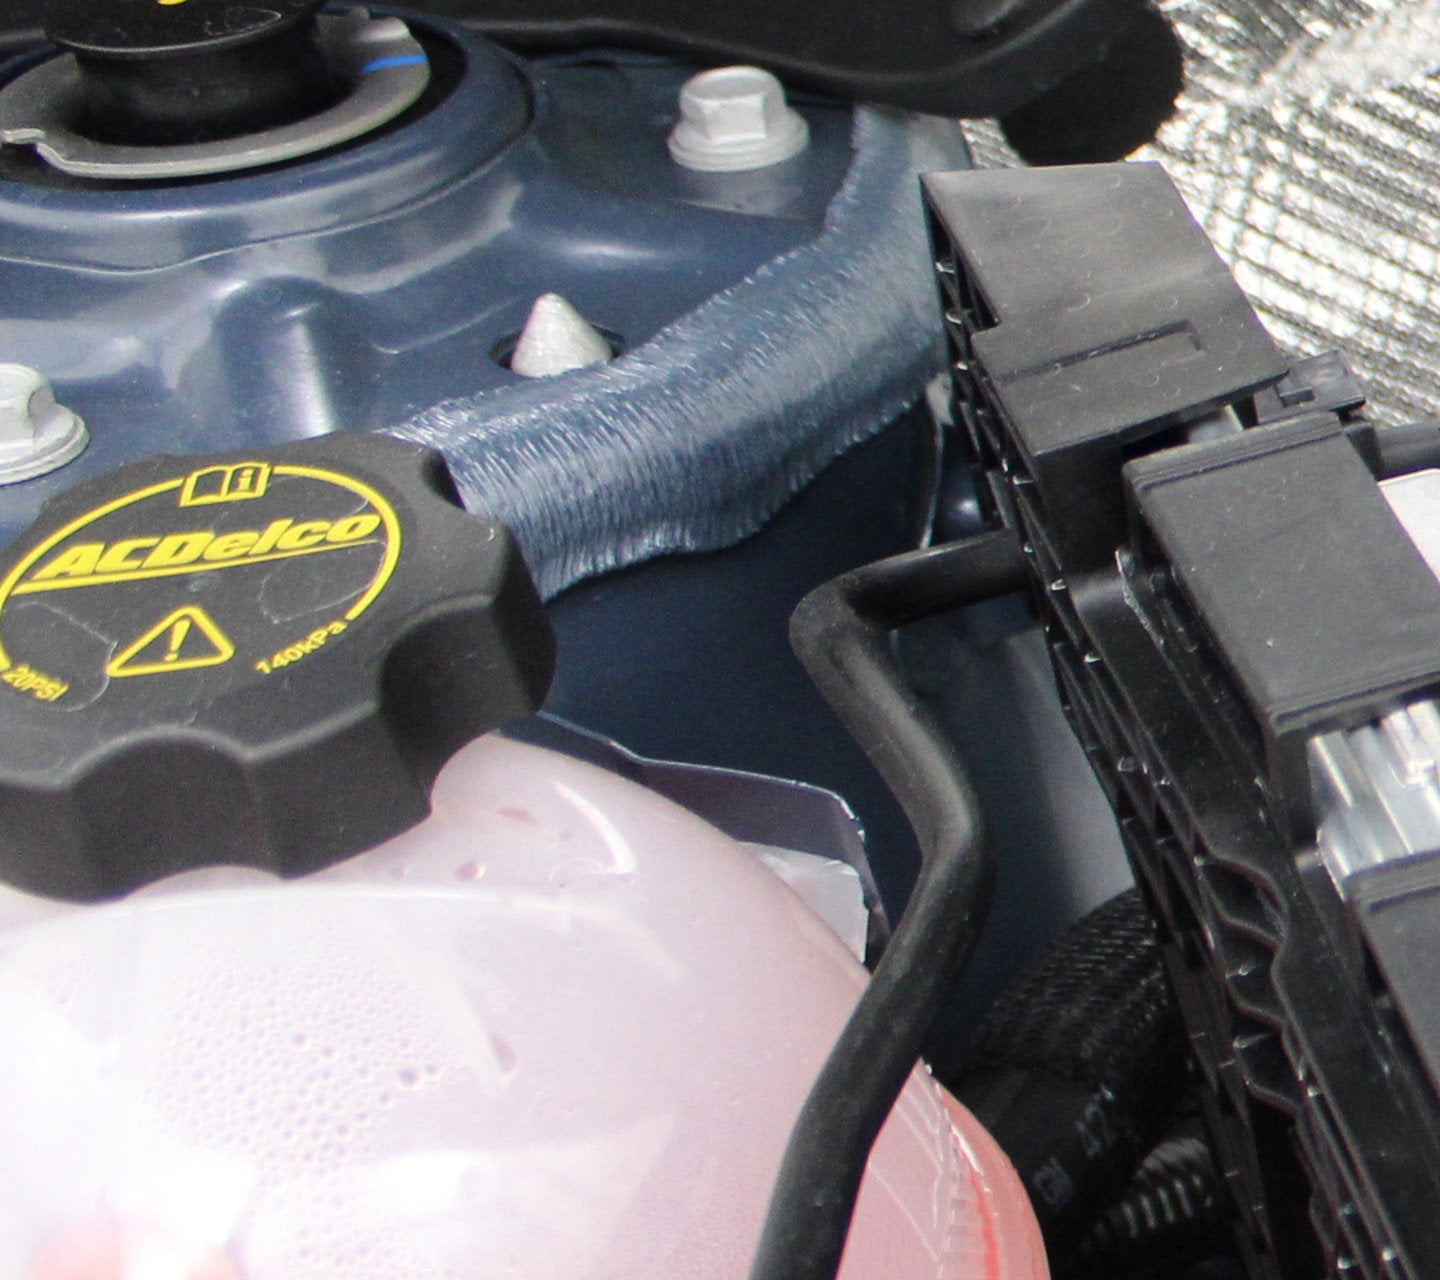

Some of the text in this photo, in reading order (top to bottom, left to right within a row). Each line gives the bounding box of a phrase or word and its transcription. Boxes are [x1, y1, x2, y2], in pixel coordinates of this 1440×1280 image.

[32, 513, 381, 581] ACDelco
[254, 619, 349, 675] 140kPa
[1, 665, 69, 703] 20PSI
